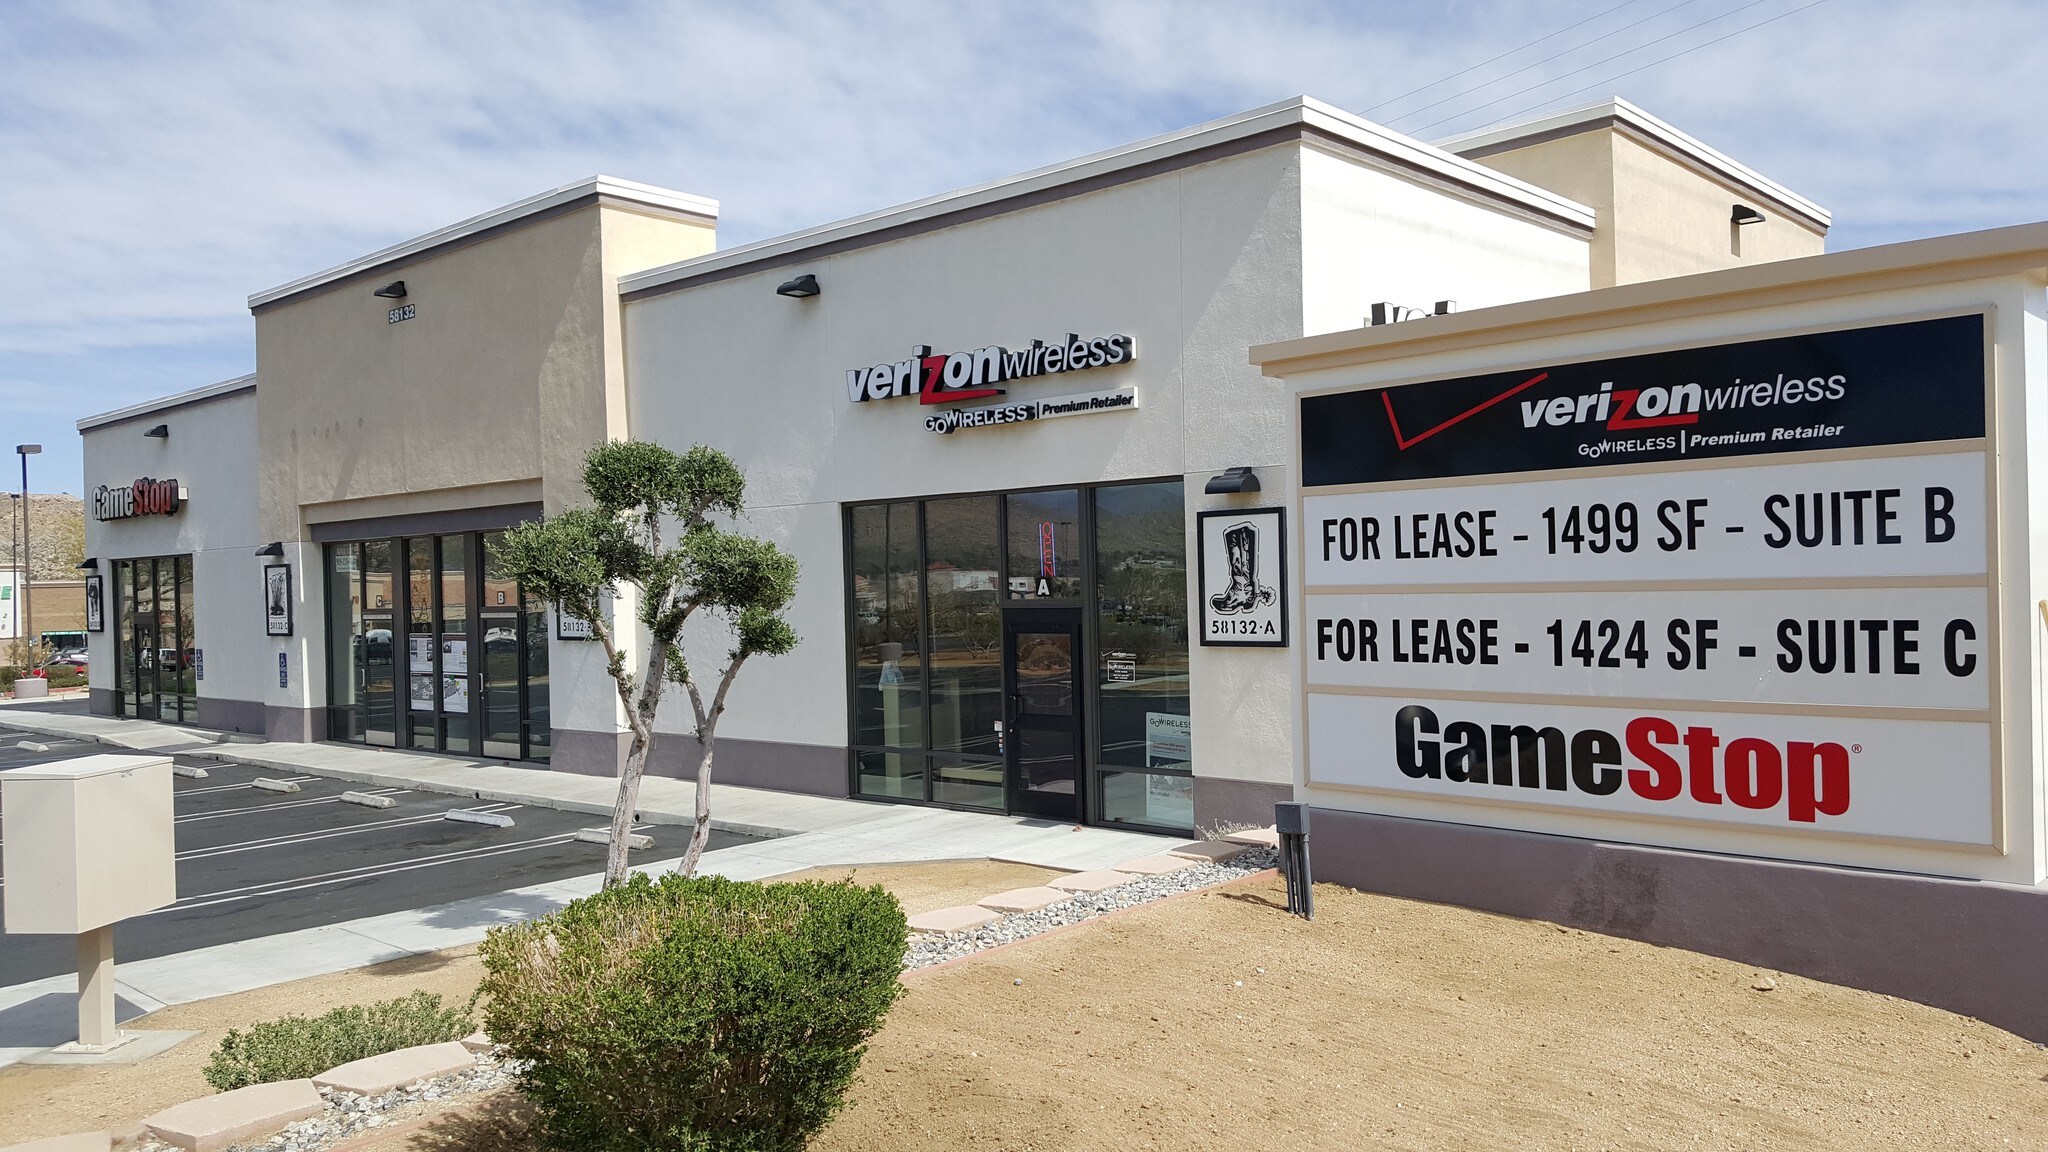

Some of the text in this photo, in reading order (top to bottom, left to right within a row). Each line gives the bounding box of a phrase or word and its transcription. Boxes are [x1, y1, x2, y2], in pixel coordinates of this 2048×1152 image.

[390, 304, 415, 323] 58132
[846, 332, 1132, 405] verizon wireless
[1041, 400, 1089, 416] Premium
[1090, 394, 1134, 409] Retailer
[1521, 373, 1846, 430] verizon wireless
[1689, 429, 1766, 447] Premium
[1771, 422, 1845, 441] Retailer
[92, 478, 173, 521] GameStop
[1322, 516, 1381, 562] FOR
[1394, 509, 1498, 560] LEASE
[1542, 501, 1639, 555] 1499
[1656, 498, 1708, 552] SF
[1763, 488, 1902, 549] SUITE
[1924, 486, 1956, 544] B
[1042, 521, 1054, 577] OPEN
[497, 591, 504, 604] B
[1037, 579, 1050, 595] A
[1317, 618, 1379, 662] FOR
[1392, 618, 1499, 665] LEASE
[1546, 619, 1649, 669] 1424
[1667, 618, 1719, 671] SF
[1776, 618, 1920, 675] SUITE
[1944, 618, 1977, 677] C
[1395, 704, 1850, 823] GameStop
